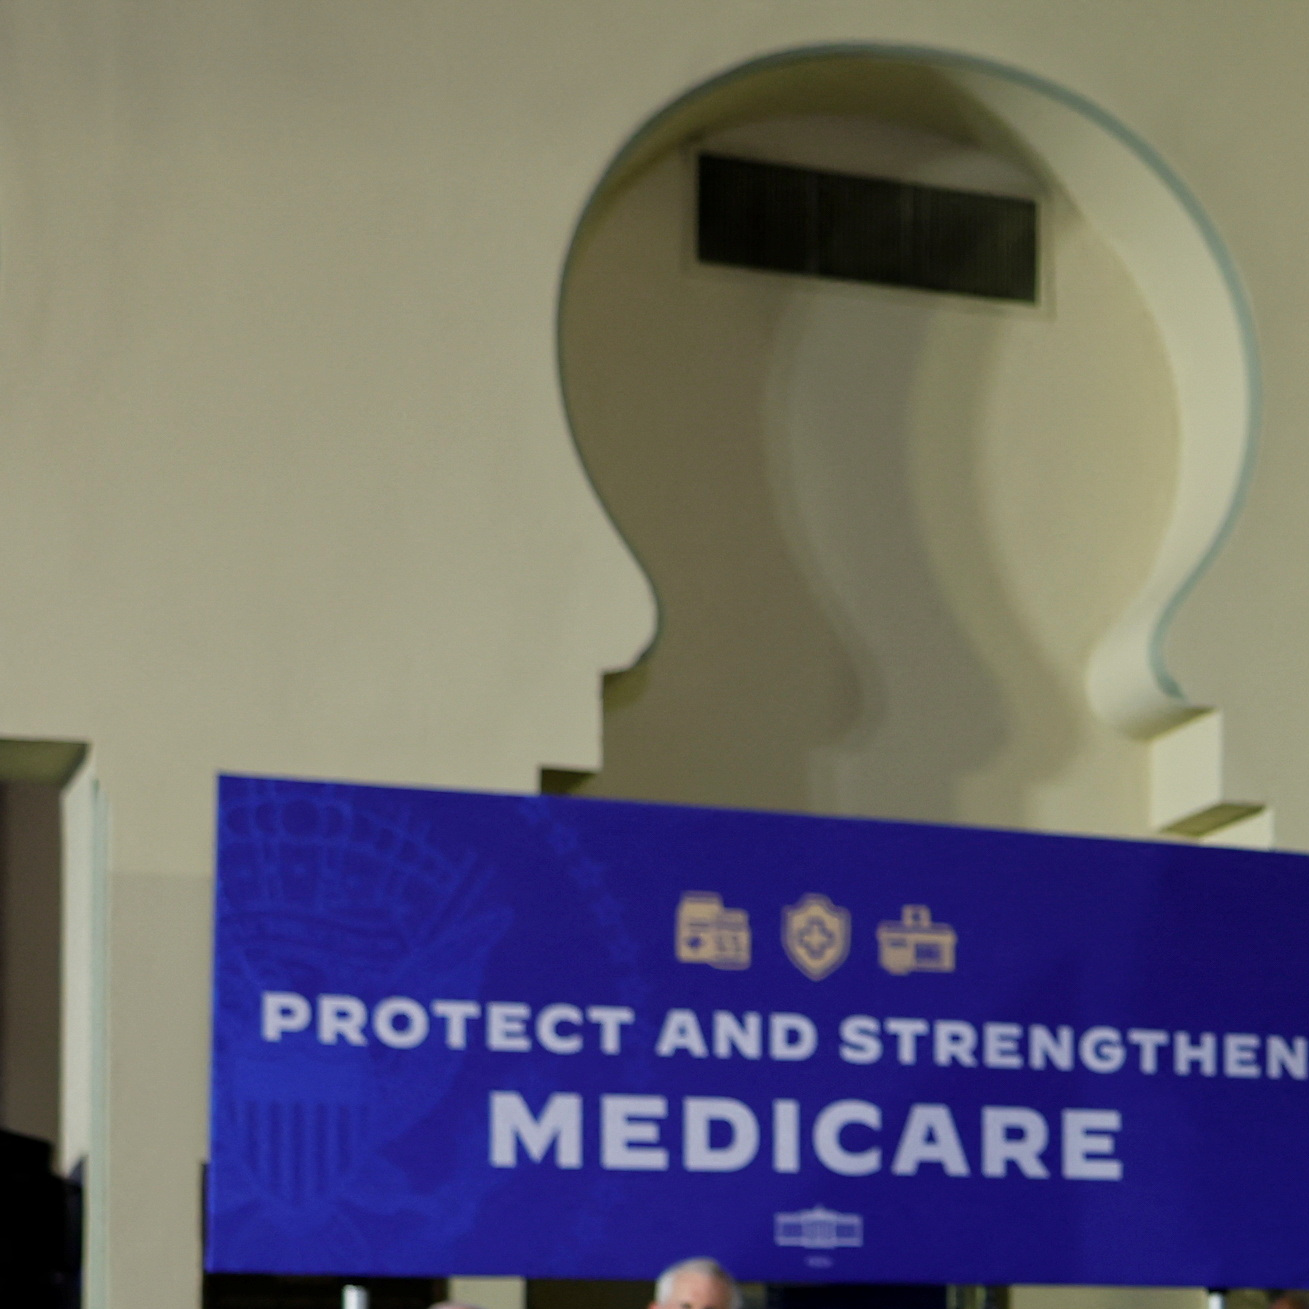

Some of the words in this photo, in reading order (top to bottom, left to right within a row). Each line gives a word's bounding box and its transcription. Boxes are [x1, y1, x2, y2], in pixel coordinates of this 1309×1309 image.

[262, 992, 634, 1054] PROTECT
[657, 1009, 817, 1060] AND
[840, 1015, 1307, 1079] STRENGTHEN
[489, 1091, 1122, 1180] MEDICARE
